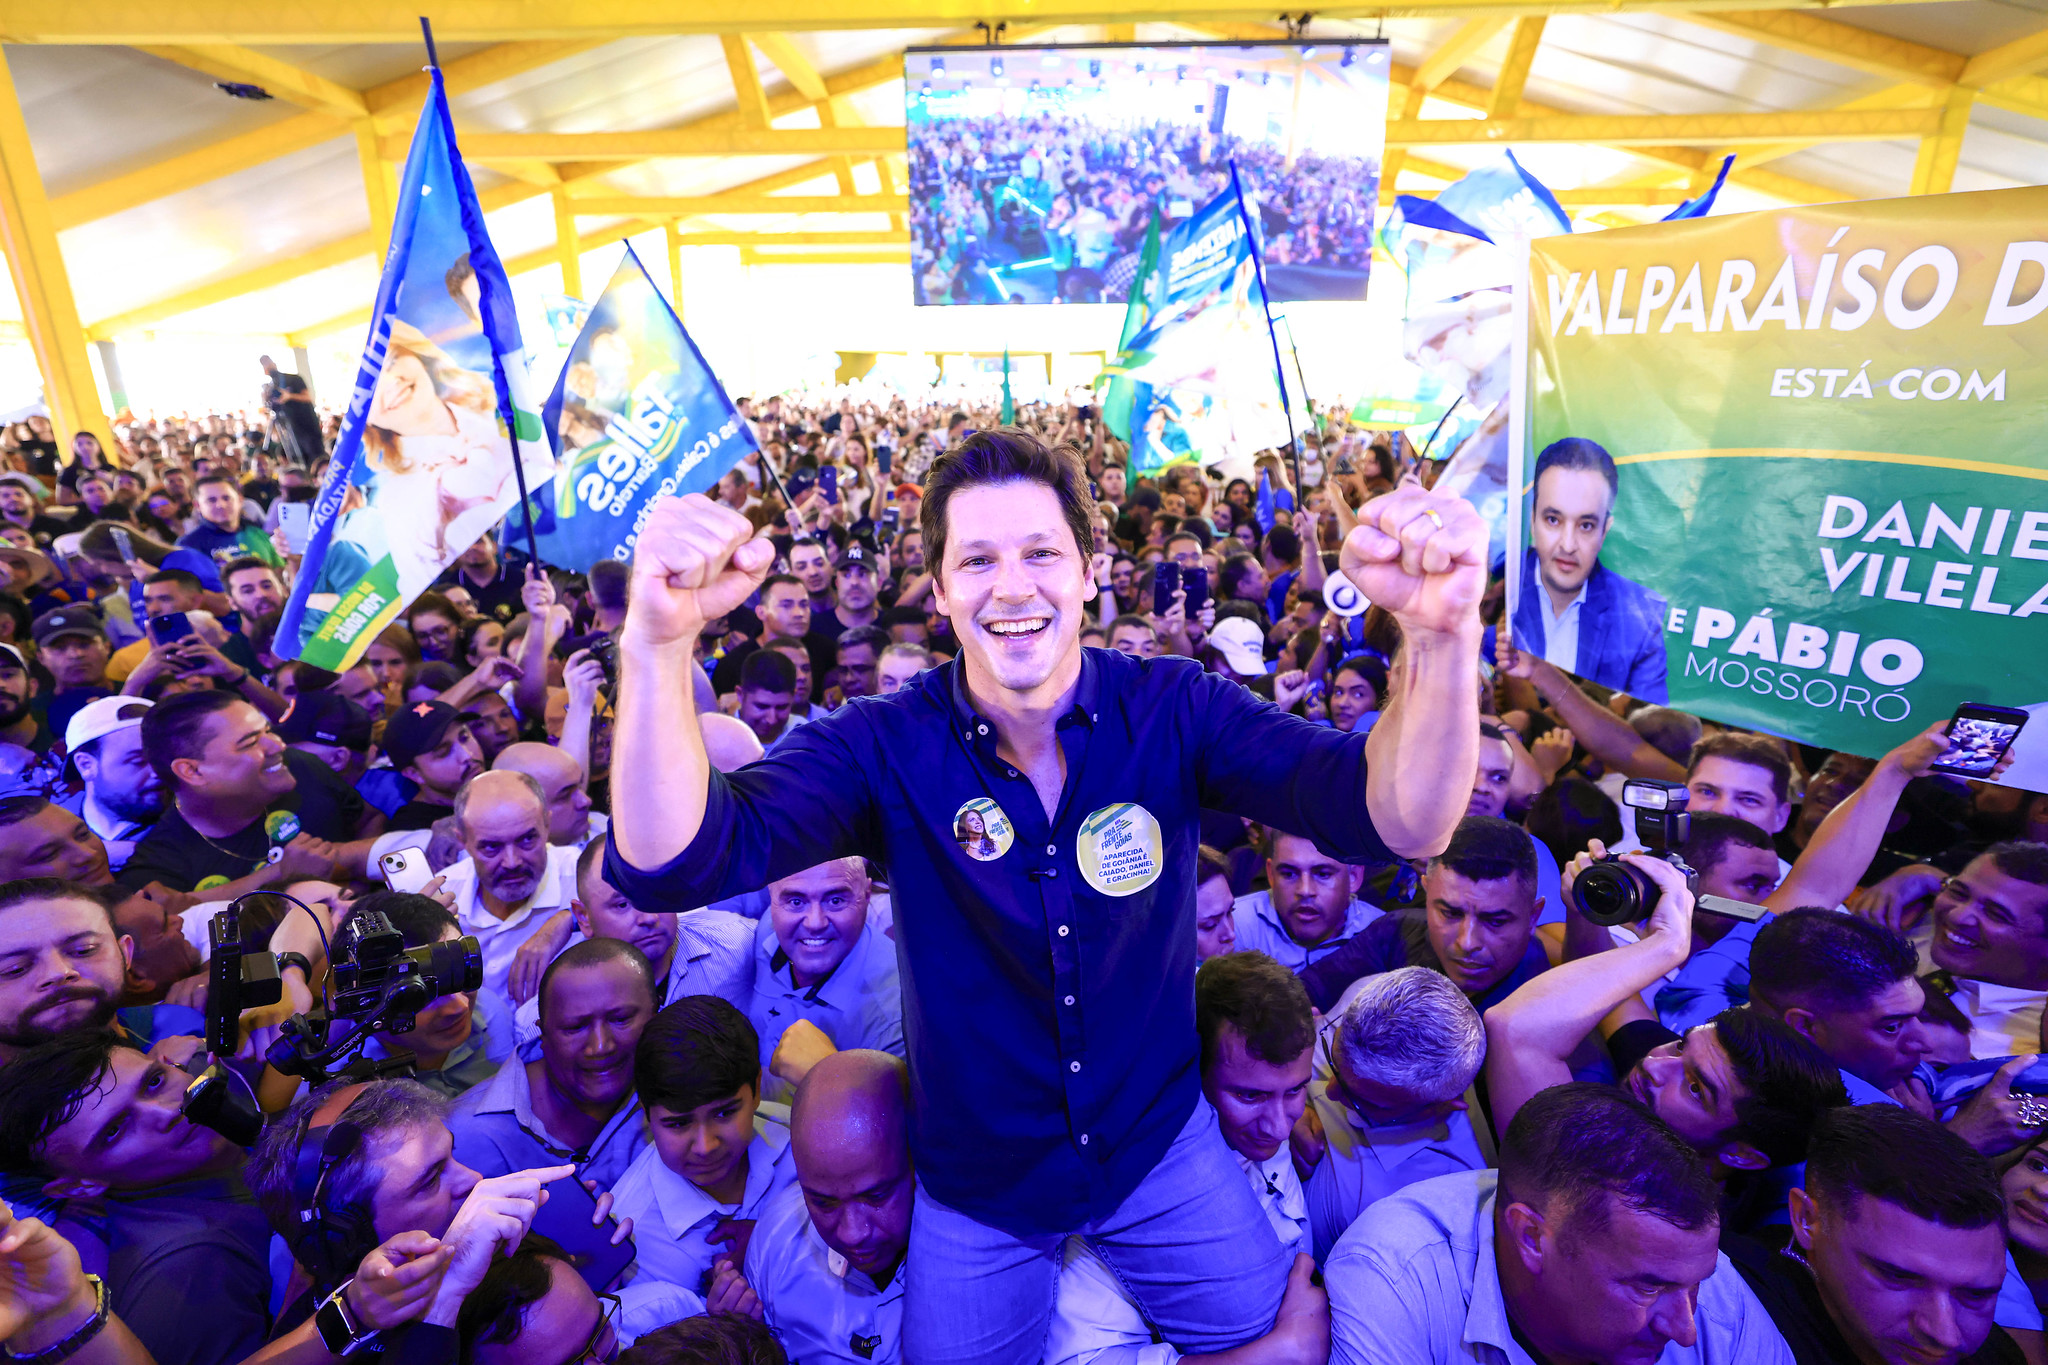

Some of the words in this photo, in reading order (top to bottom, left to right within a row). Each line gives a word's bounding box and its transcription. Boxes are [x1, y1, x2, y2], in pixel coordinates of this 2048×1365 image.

[1547, 226, 1959, 337] VALPARAÍSO
[1770, 360, 1874, 399] ESTÁ
[1889, 368, 2007, 401] COM
[1667, 606, 1688, 634] E
[1691, 604, 1925, 687] PÁBIO
[1685, 651, 1912, 723] MOSSORÓ
[1101, 830, 1123, 850] FRENTE
[1104, 826, 1116, 840] PRA
[1103, 847, 1143, 861] APARECIDA
[1112, 854, 1142, 867] GOIÂNIA
[1143, 852, 1148, 860] É
[1098, 866, 1128, 877] CAIADO,
[1129, 860, 1154, 872] DANIEL
[1112, 868, 1150, 883] GRACINHA!
